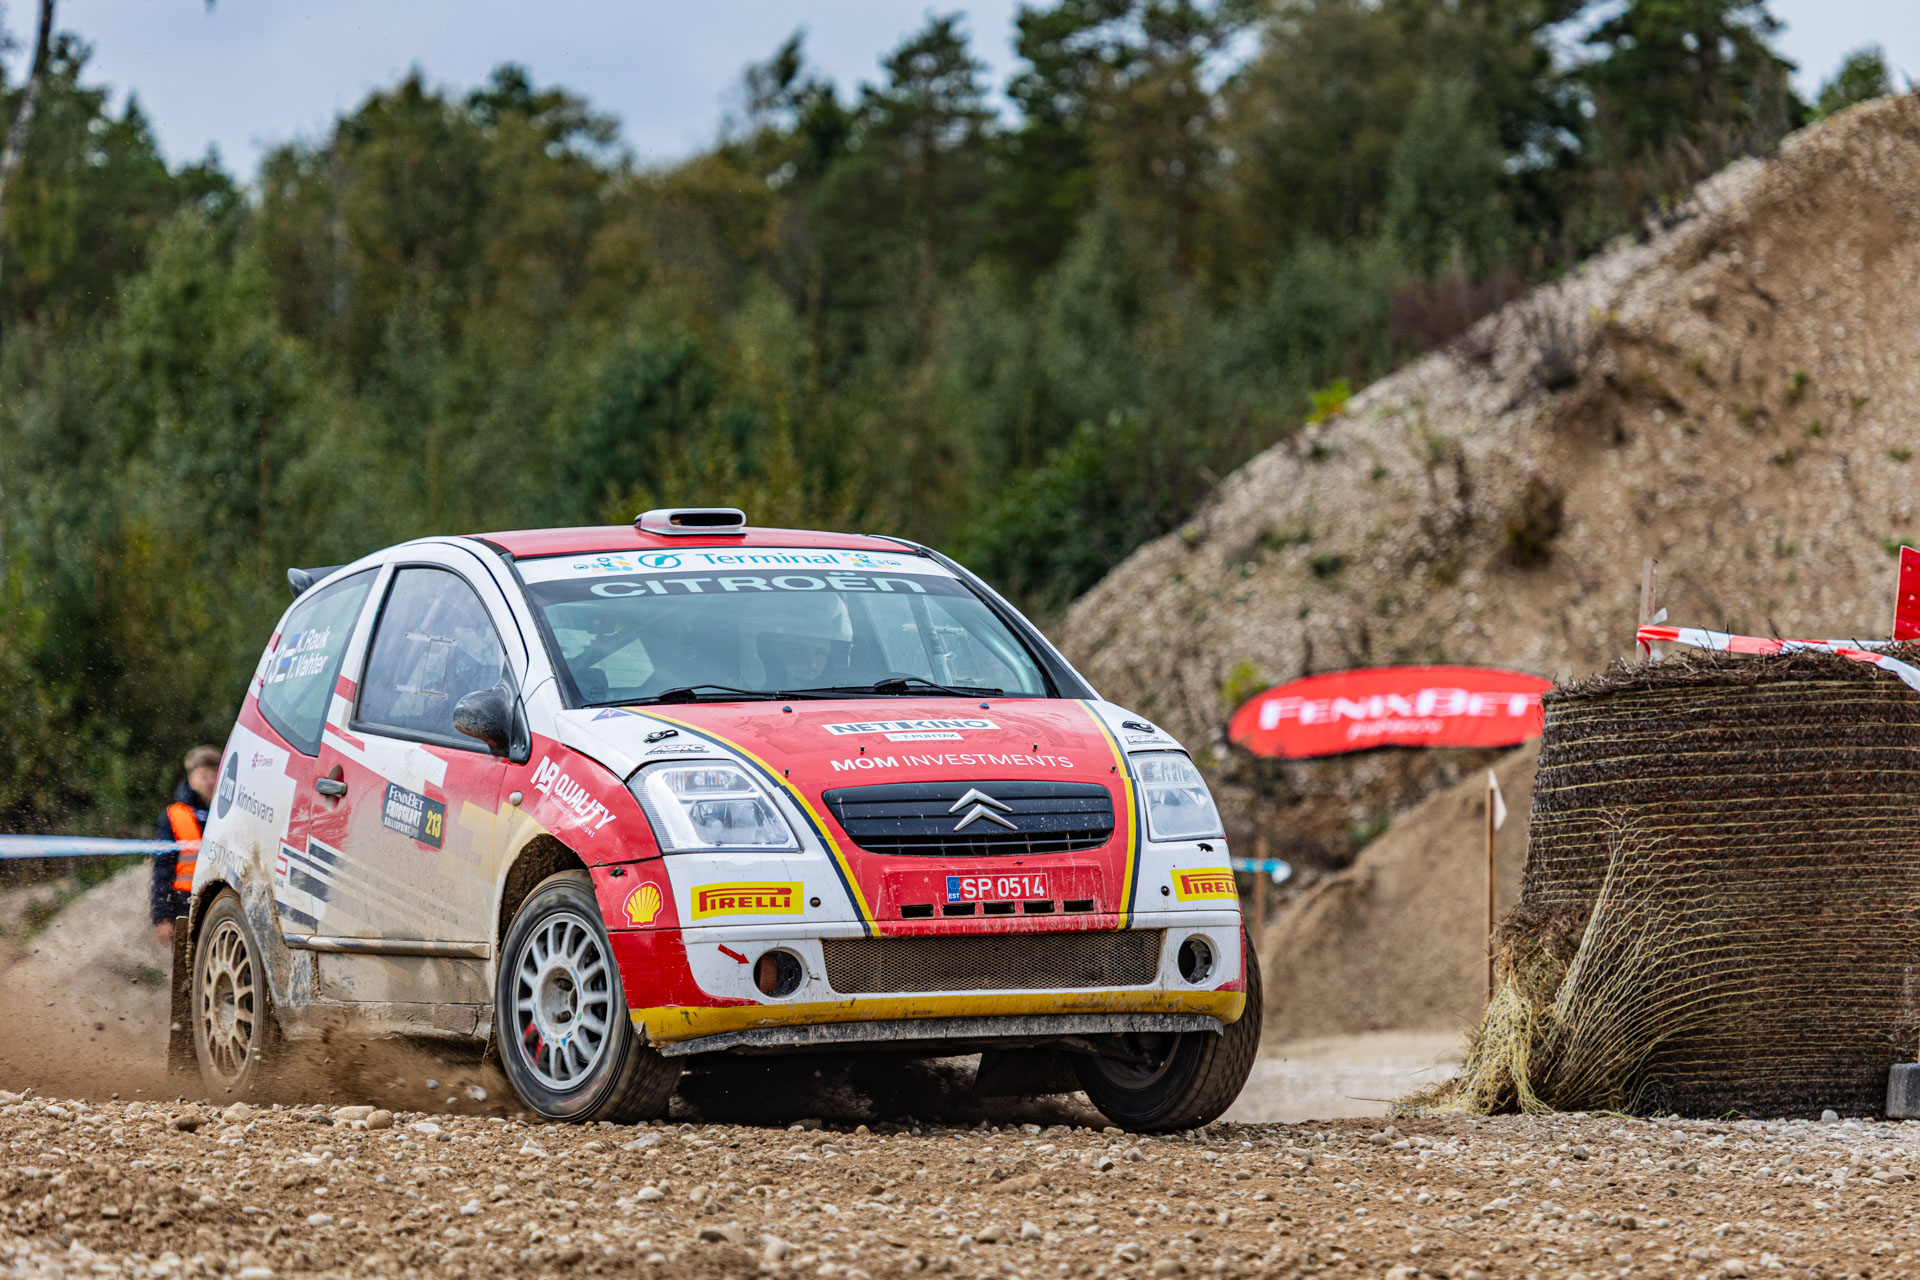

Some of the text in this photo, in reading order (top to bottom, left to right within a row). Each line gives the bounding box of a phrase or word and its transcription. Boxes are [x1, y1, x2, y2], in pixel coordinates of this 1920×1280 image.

[695, 552, 840, 566] Terminal
[834, 720, 880, 734] NET
[830, 754, 1074, 772] MOM INVESTMENTS
[236, 783, 275, 824] kinnisvara
[554, 773, 617, 830] QUALITY
[425, 809, 442, 839] 213
[699, 887, 792, 912] PIRELLI
[962, 876, 1045, 899] SP 0514
